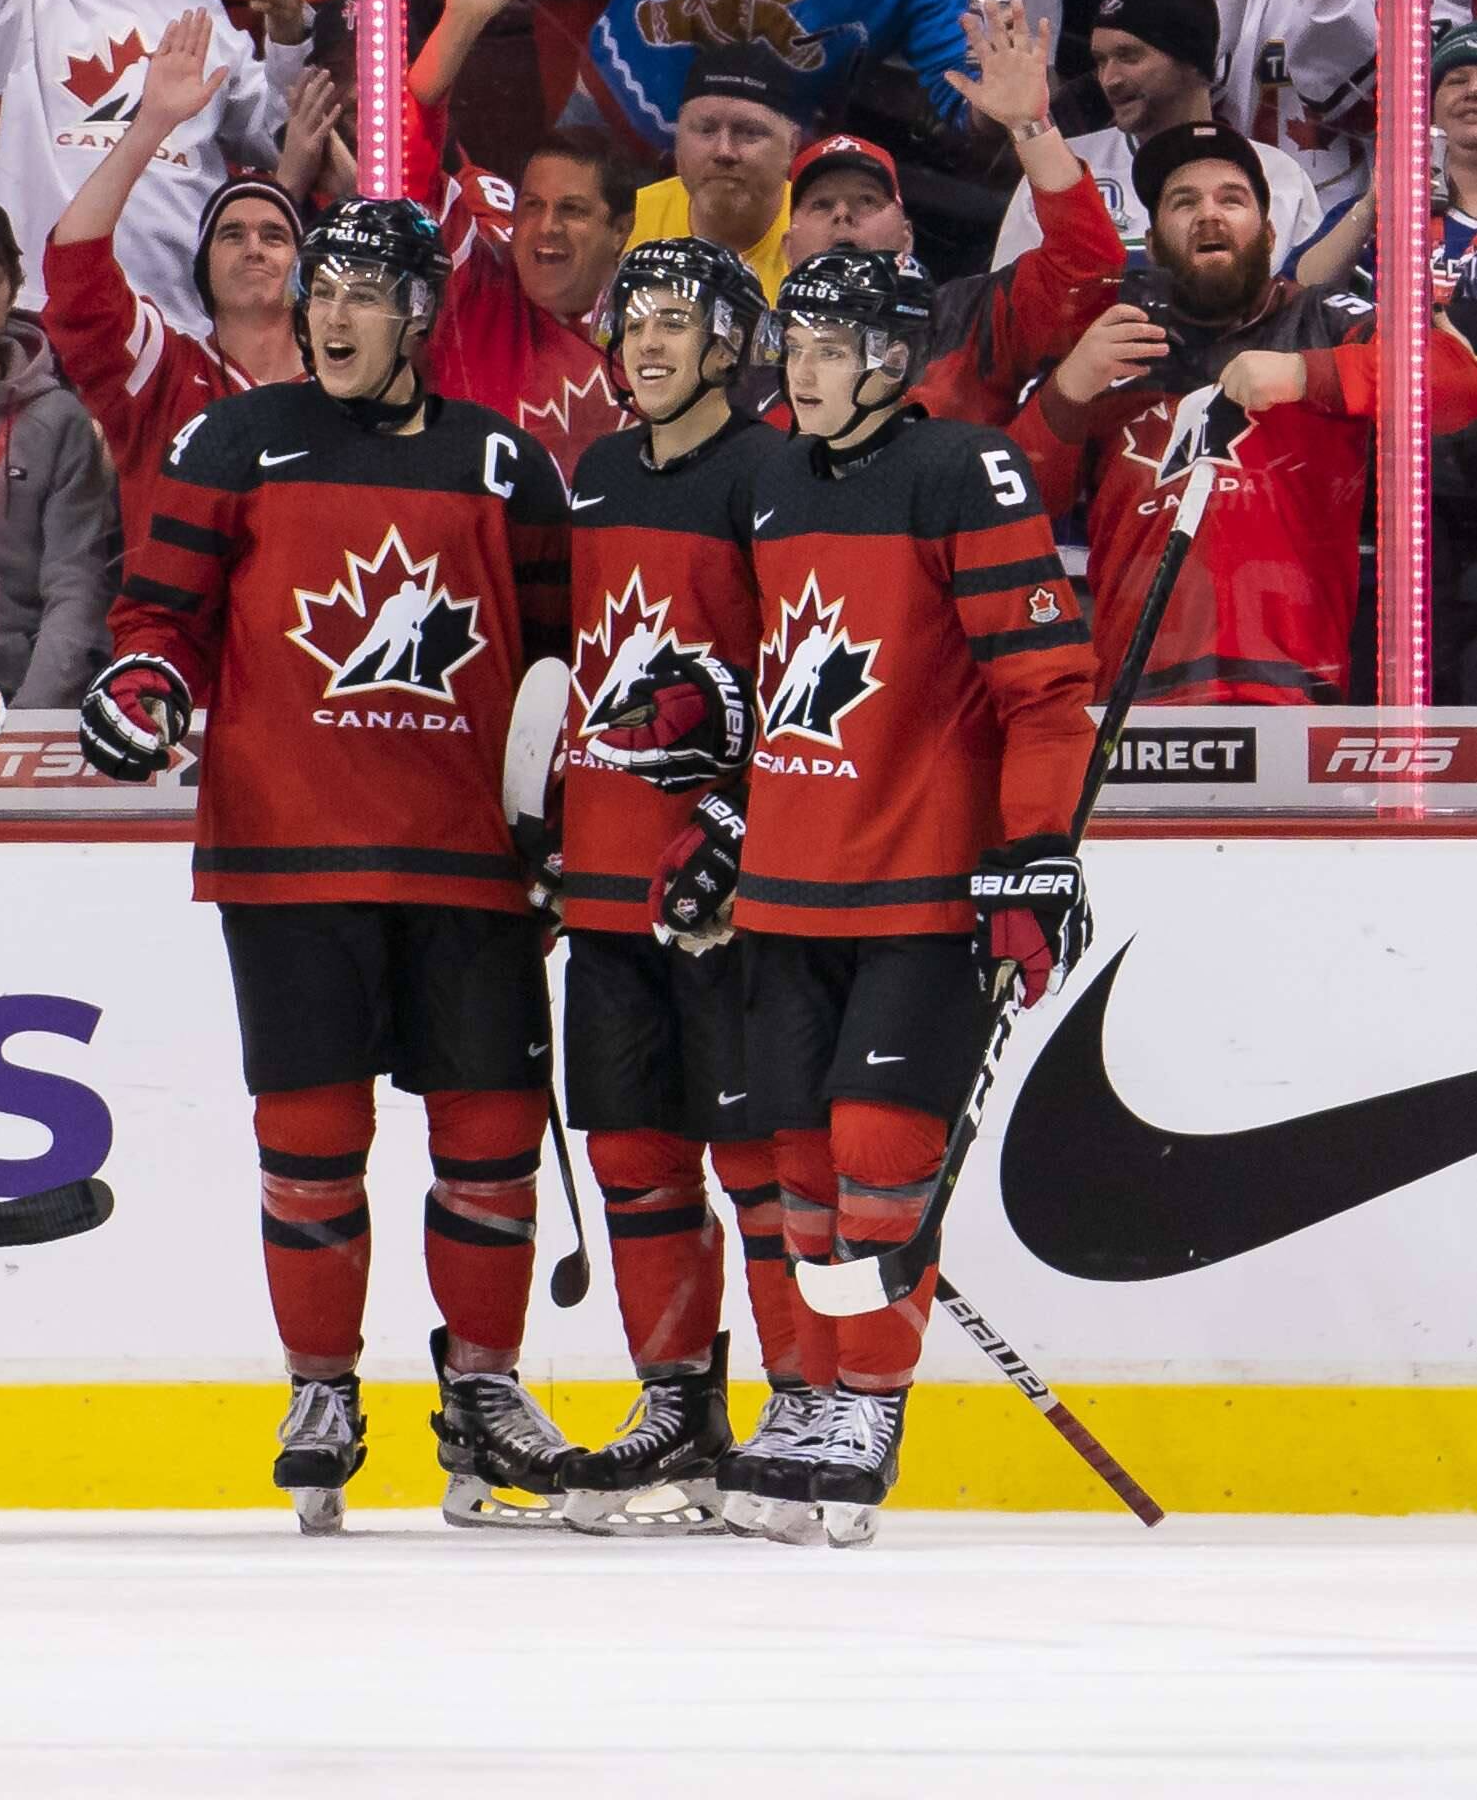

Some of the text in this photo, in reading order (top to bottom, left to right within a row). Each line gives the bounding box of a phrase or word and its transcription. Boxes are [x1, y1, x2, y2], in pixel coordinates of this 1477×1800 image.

[56, 132, 190, 168] CANDA
[326, 227, 382, 247] TELUS
[633, 248, 688, 264] TELUS
[790, 282, 841, 303] TELUS
[483, 432, 519, 500] C
[980, 449, 1027, 507] 5
[1136, 477, 1257, 517] CADA
[312, 708, 471, 734] CANADA
[0, 741, 96, 779] TS
[1325, 737, 1462, 773] RDS
[970, 874, 1075, 897] BAUER
